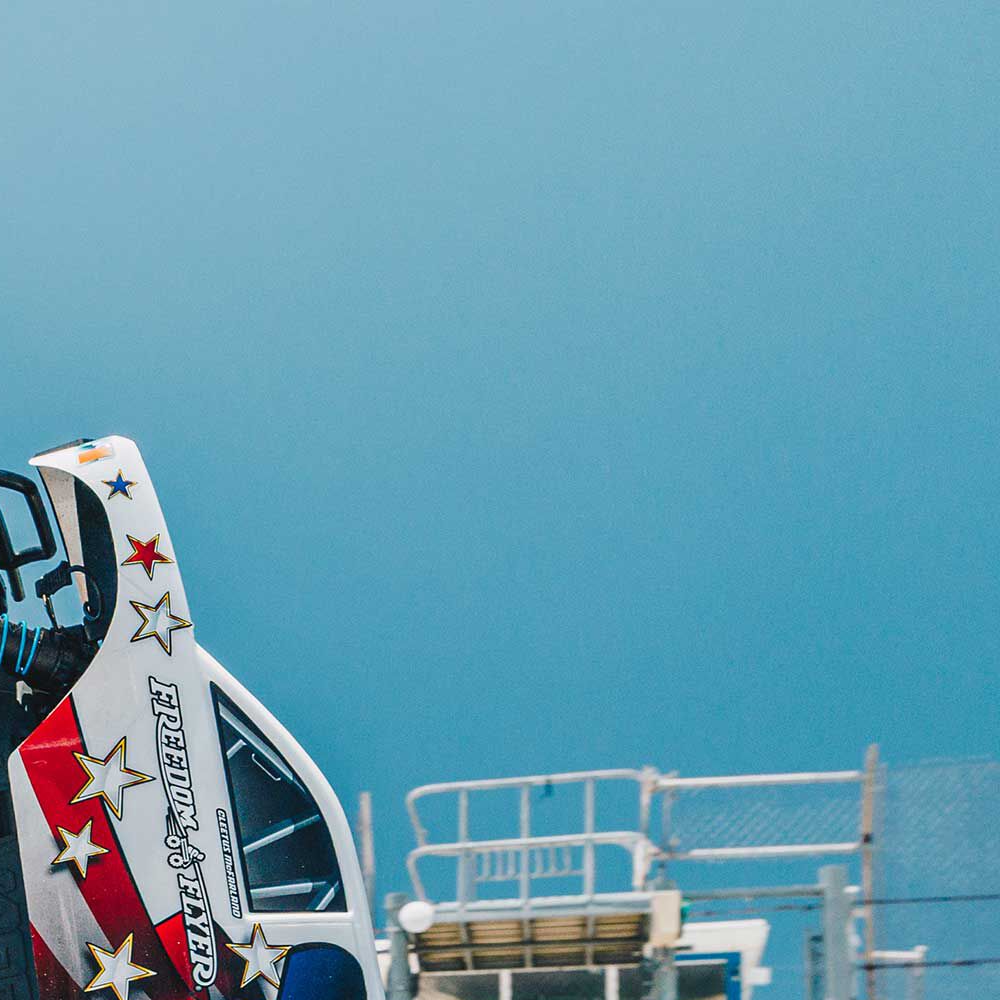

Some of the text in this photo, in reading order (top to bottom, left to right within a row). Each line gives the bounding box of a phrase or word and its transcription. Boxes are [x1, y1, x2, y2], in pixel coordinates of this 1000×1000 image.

[149, 676, 217, 987] FREEDOM FLYER
[217, 809, 231, 854] CLEETUS
